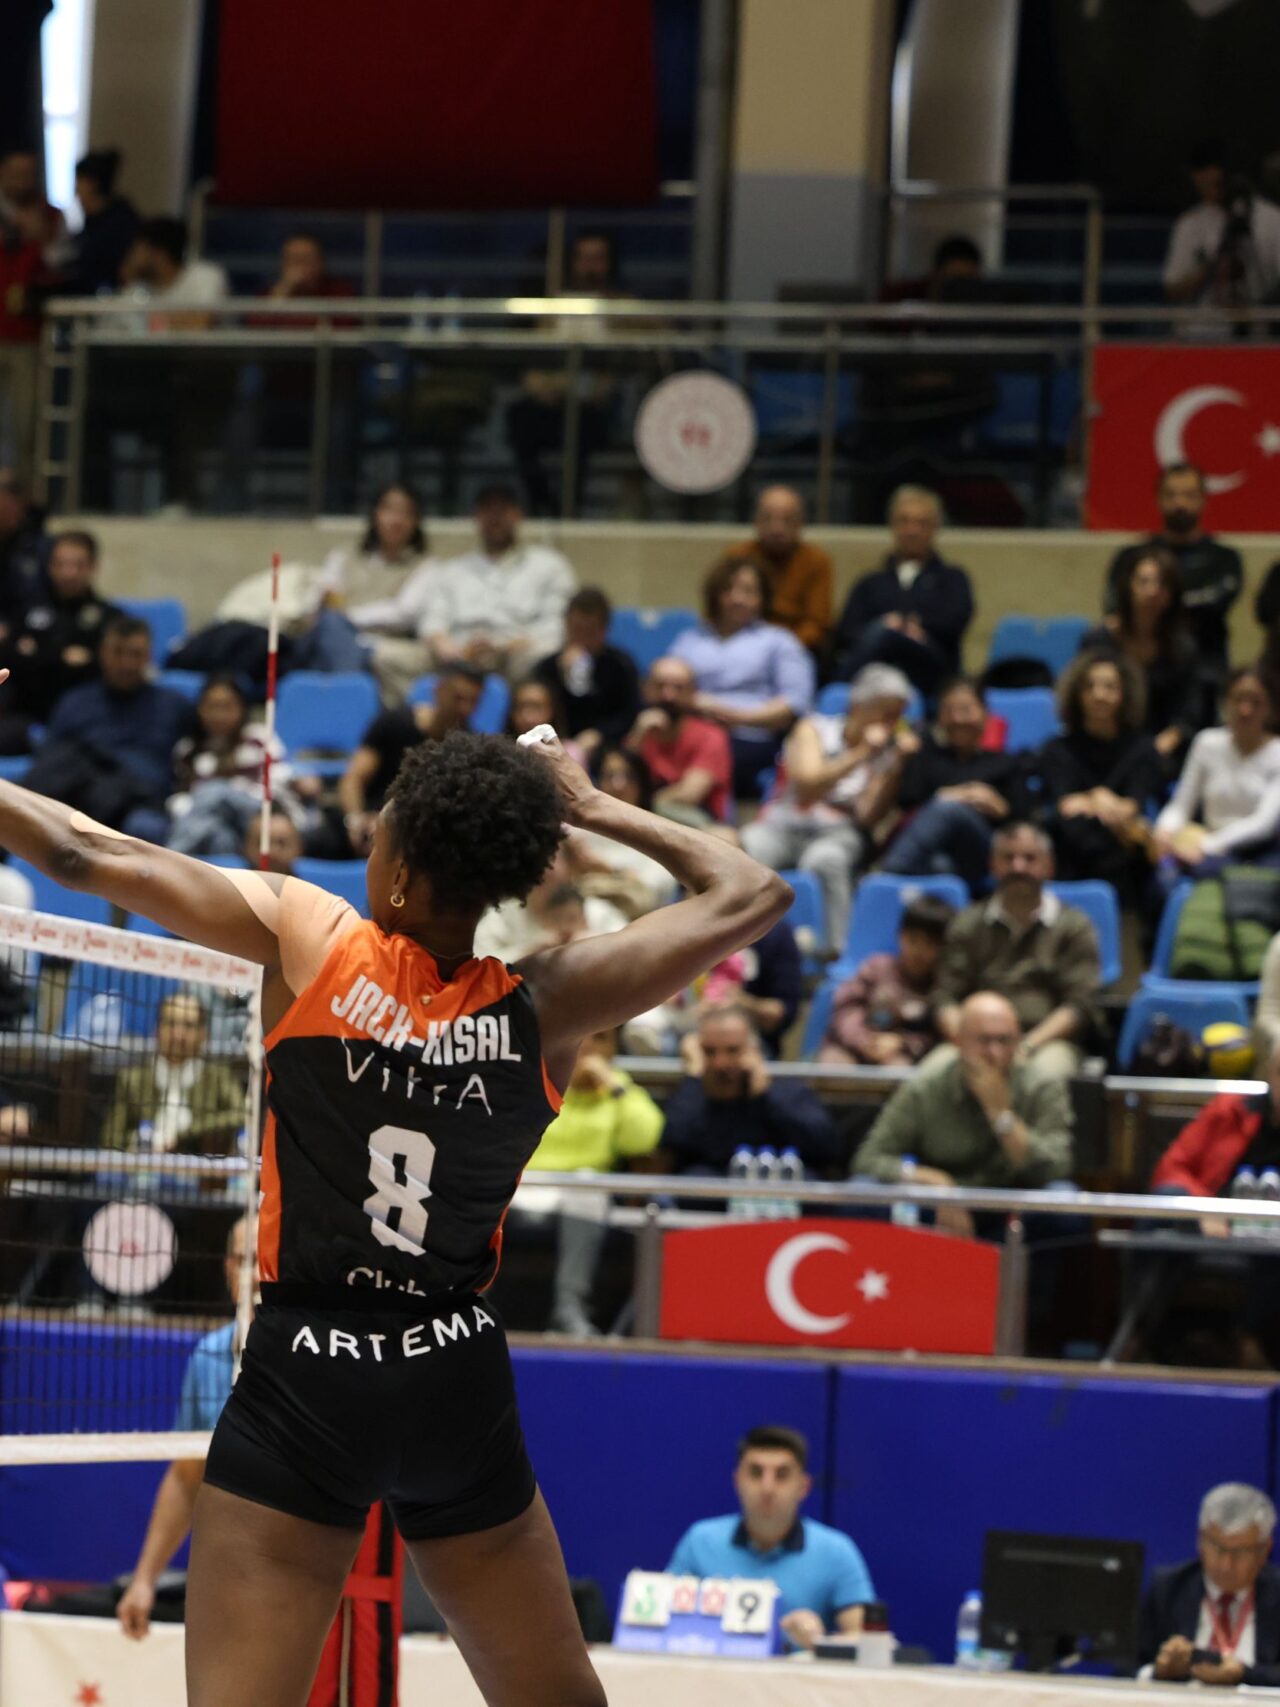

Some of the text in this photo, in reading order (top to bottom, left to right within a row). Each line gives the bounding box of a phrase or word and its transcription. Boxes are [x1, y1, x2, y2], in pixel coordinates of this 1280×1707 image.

[363, 1124, 436, 1257] 8
[292, 1305, 495, 1362] ARTEMA
[738, 1592, 760, 1622] 9
